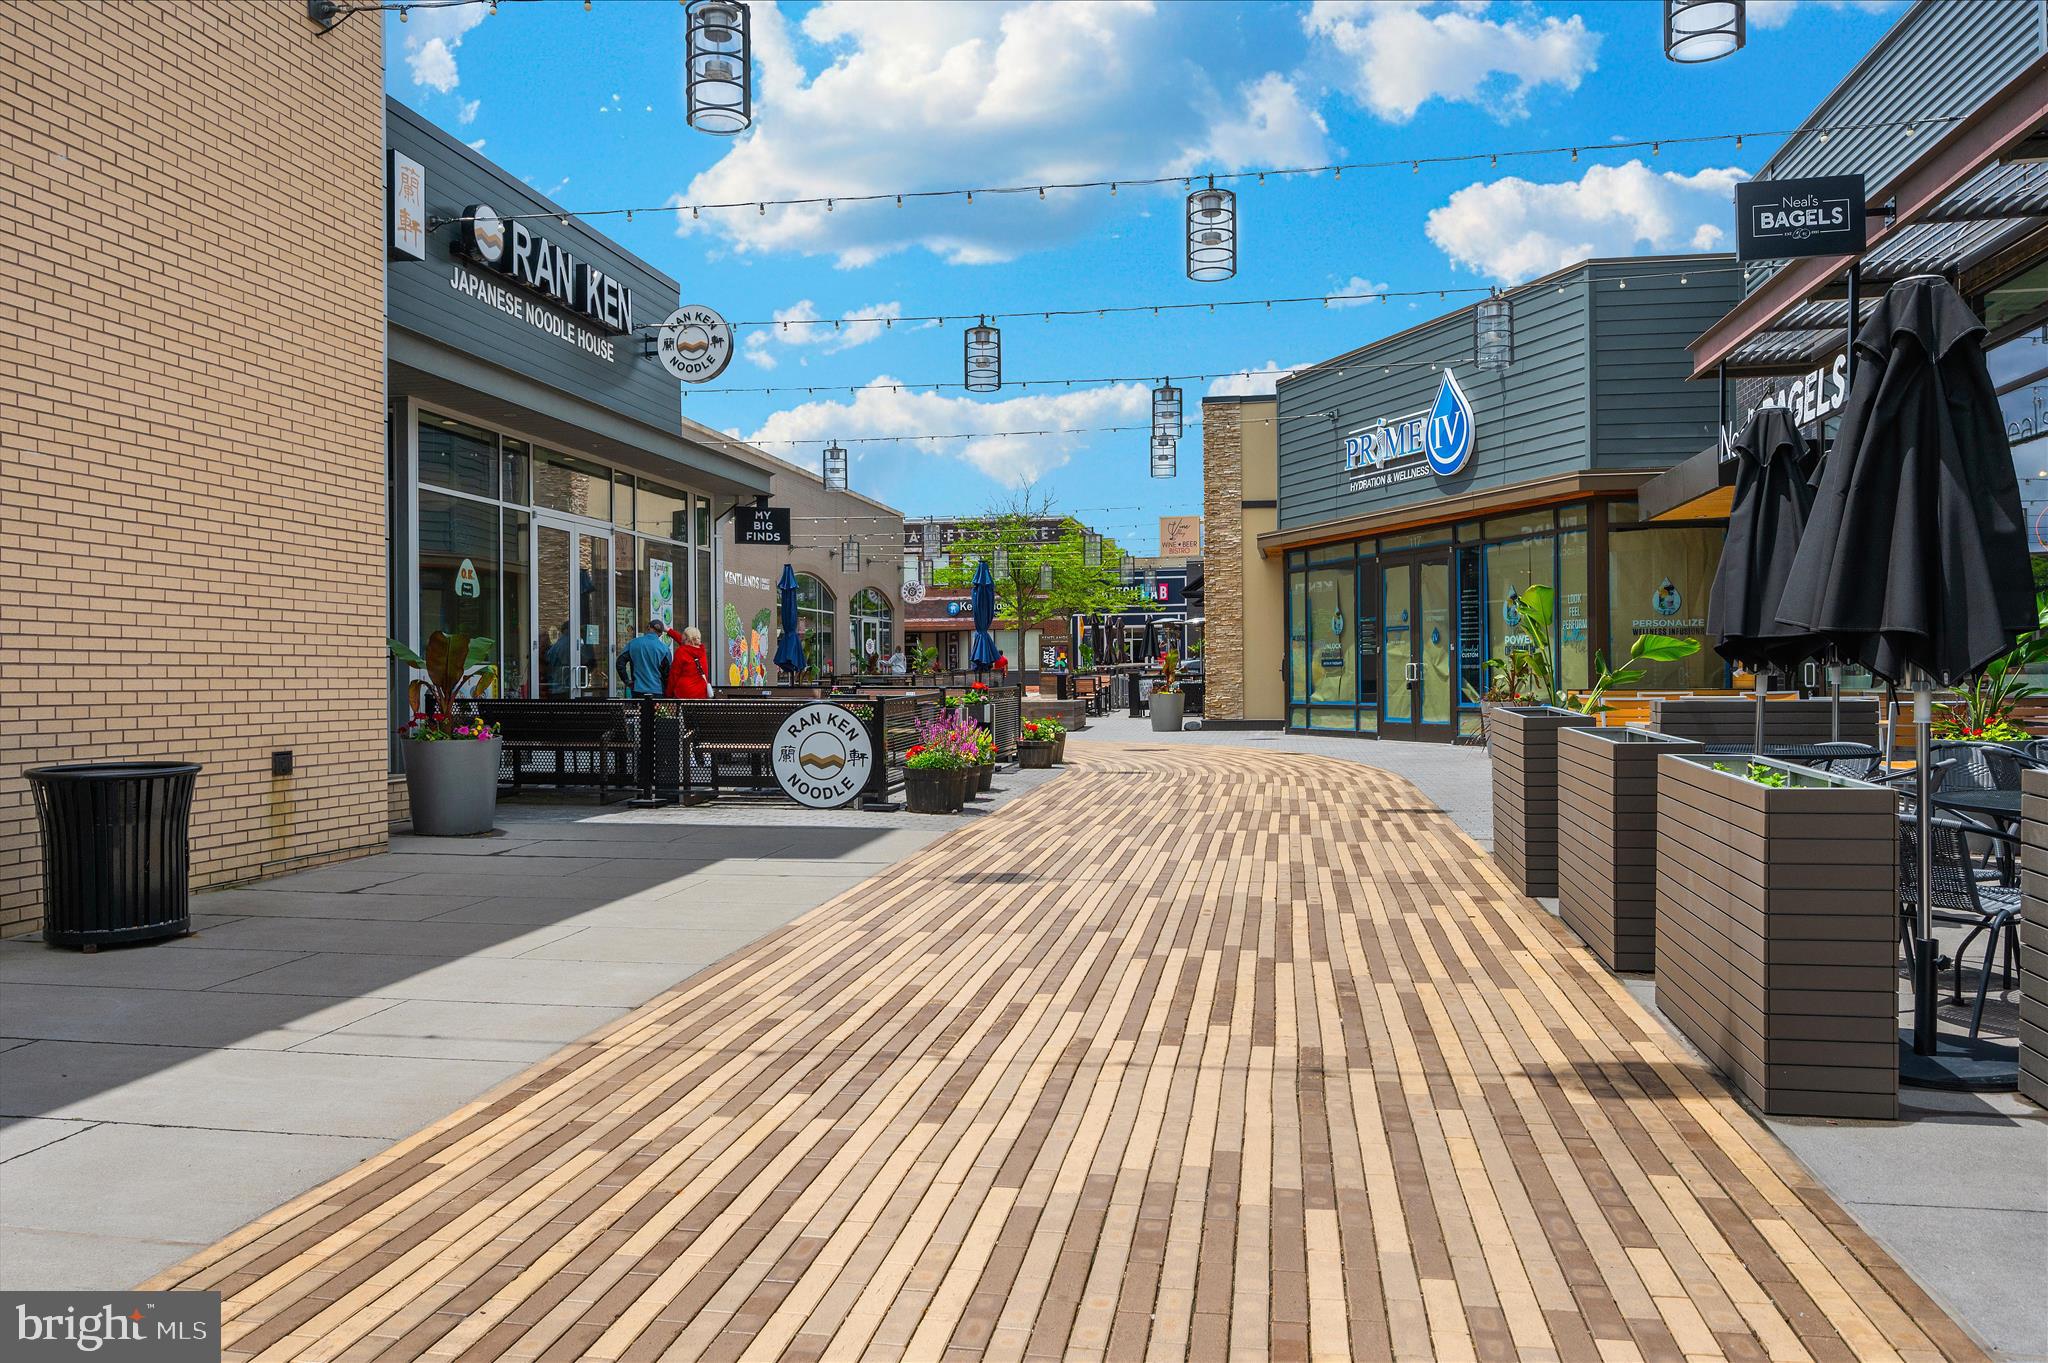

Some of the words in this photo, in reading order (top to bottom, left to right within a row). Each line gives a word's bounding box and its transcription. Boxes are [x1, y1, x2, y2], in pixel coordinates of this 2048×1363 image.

[1782, 194, 1819, 208] Neal's
[1760, 207, 1843, 229] BAGELS
[512, 220, 573, 304] RAN
[586, 264, 633, 335] KEN
[450, 267, 523, 319] JAPANESE
[526, 305, 575, 344] NOODLE
[577, 327, 615, 362] HOUSE
[668, 311, 691, 333] RAN
[694, 311, 717, 331] KEN
[669, 354, 716, 373] NOODLE
[1433, 411, 1462, 450] IV
[1350, 475, 1386, 492] HYDRATION
[1386, 474, 1393, 483] &
[1393, 465, 1430, 482] WELLNESS
[755, 511, 771, 520] MY
[753, 521, 773, 531] BIG
[746, 532, 781, 541] FINDS
[724, 570, 760, 590] KENTLANDS
[1567, 594, 1582, 605] LOOK
[1568, 607, 1581, 617] FEEL
[1632, 619, 1705, 627] PERSONALIZE
[1632, 628, 1667, 636] WELLNESS
[1668, 627, 1705, 636] INFUSIONS
[787, 712, 821, 738] RAN
[826, 713, 859, 742] KEN
[787, 773, 855, 800] NOODLE
